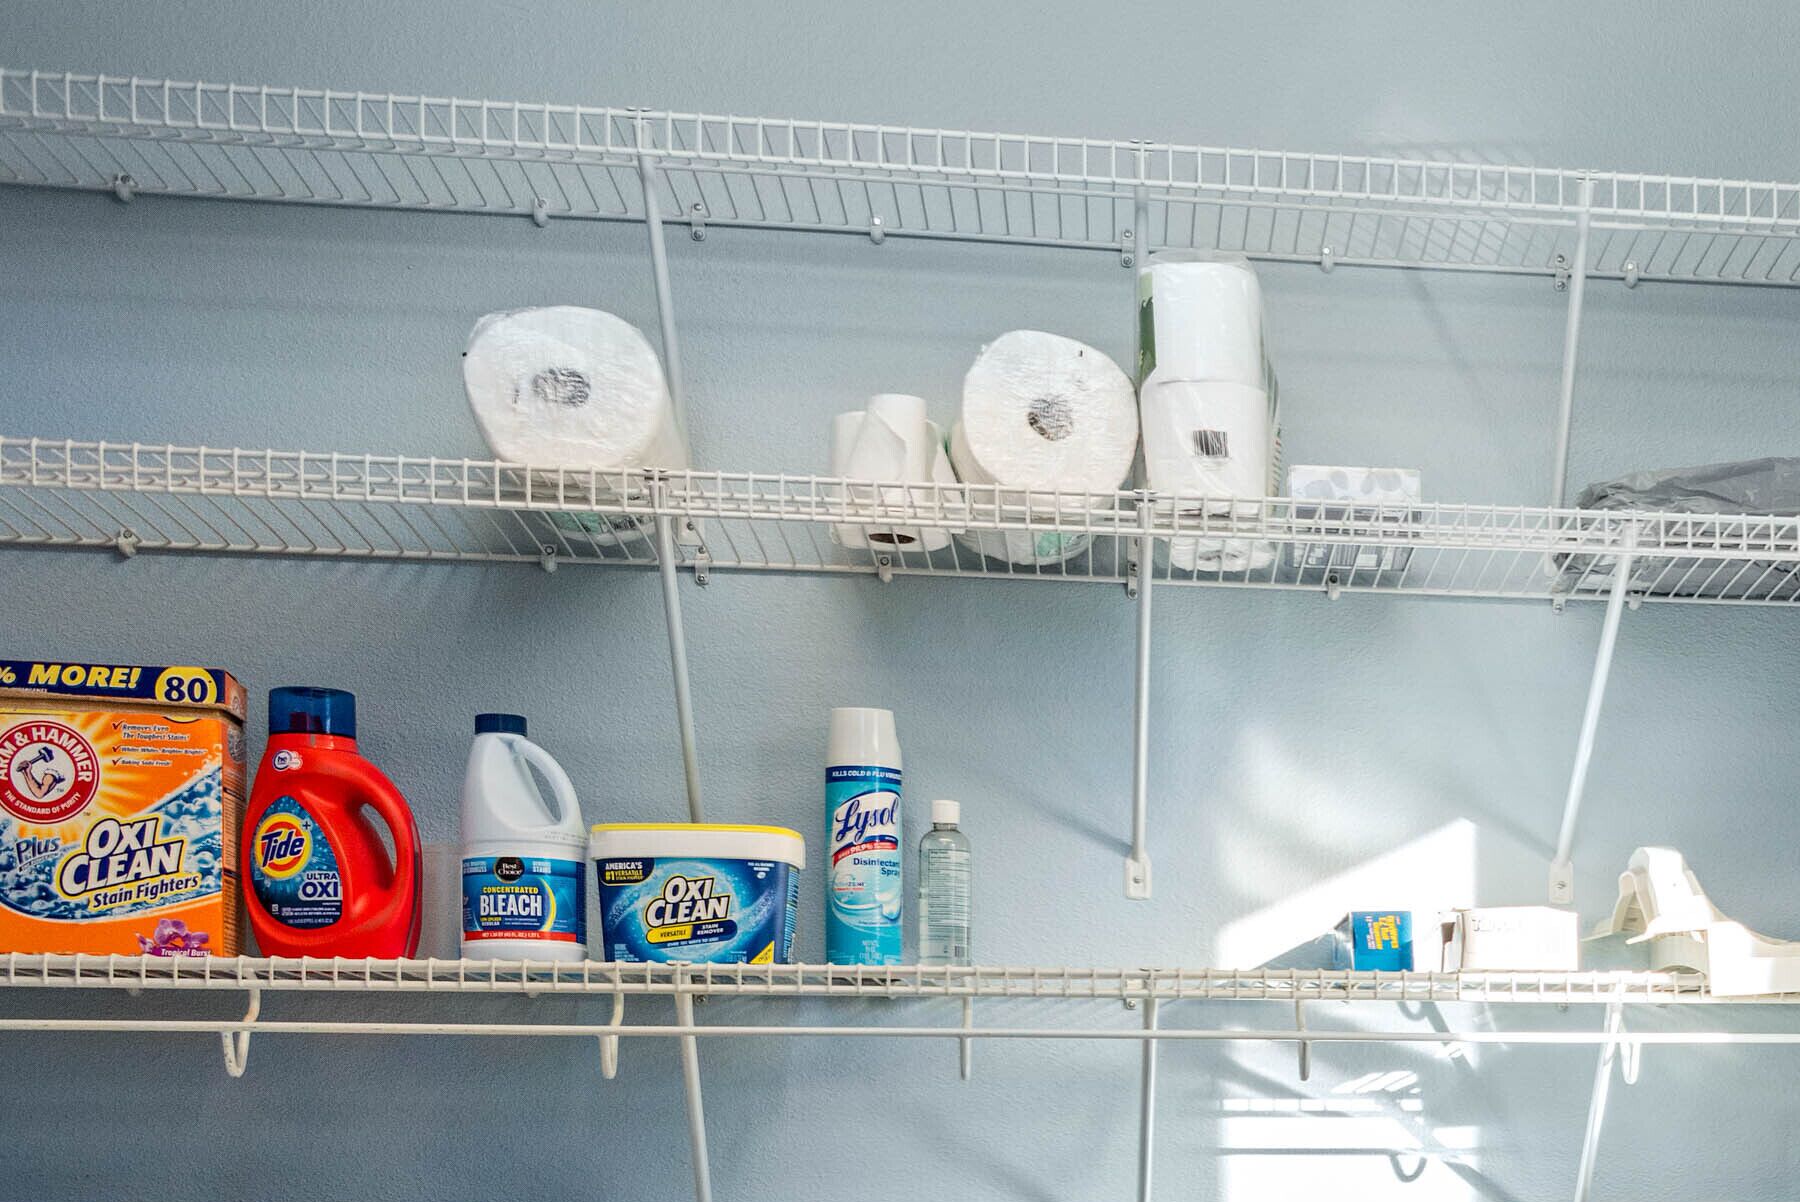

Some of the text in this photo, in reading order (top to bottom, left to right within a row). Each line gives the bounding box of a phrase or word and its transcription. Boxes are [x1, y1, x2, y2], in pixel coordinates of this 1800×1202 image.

[28, 664, 142, 689] MORE!
[14, 731, 30, 747] &
[32, 727, 93, 783] HAMMER
[15, 800, 51, 815] STANDARD
[835, 798, 899, 843] Lysol
[16, 836, 61, 864] Plus
[86, 817, 157, 860] OXI
[260, 830, 305, 869] Tide
[60, 840, 184, 896] CLEAN
[502, 862, 517, 870] Best
[605, 861, 643, 870] AMERICA'S
[852, 857, 900, 868] Disinecta
[306, 872, 338, 881] ULTRA
[94, 876, 199, 908] Stain Fighters
[301, 881, 339, 898] OXI
[482, 886, 539, 894] CONCENTRATED
[665, 875, 714, 904] OXI
[479, 894, 543, 917] BLEACH
[646, 896, 729, 928] CLEAN
[659, 930, 687, 939] VERSATILE
